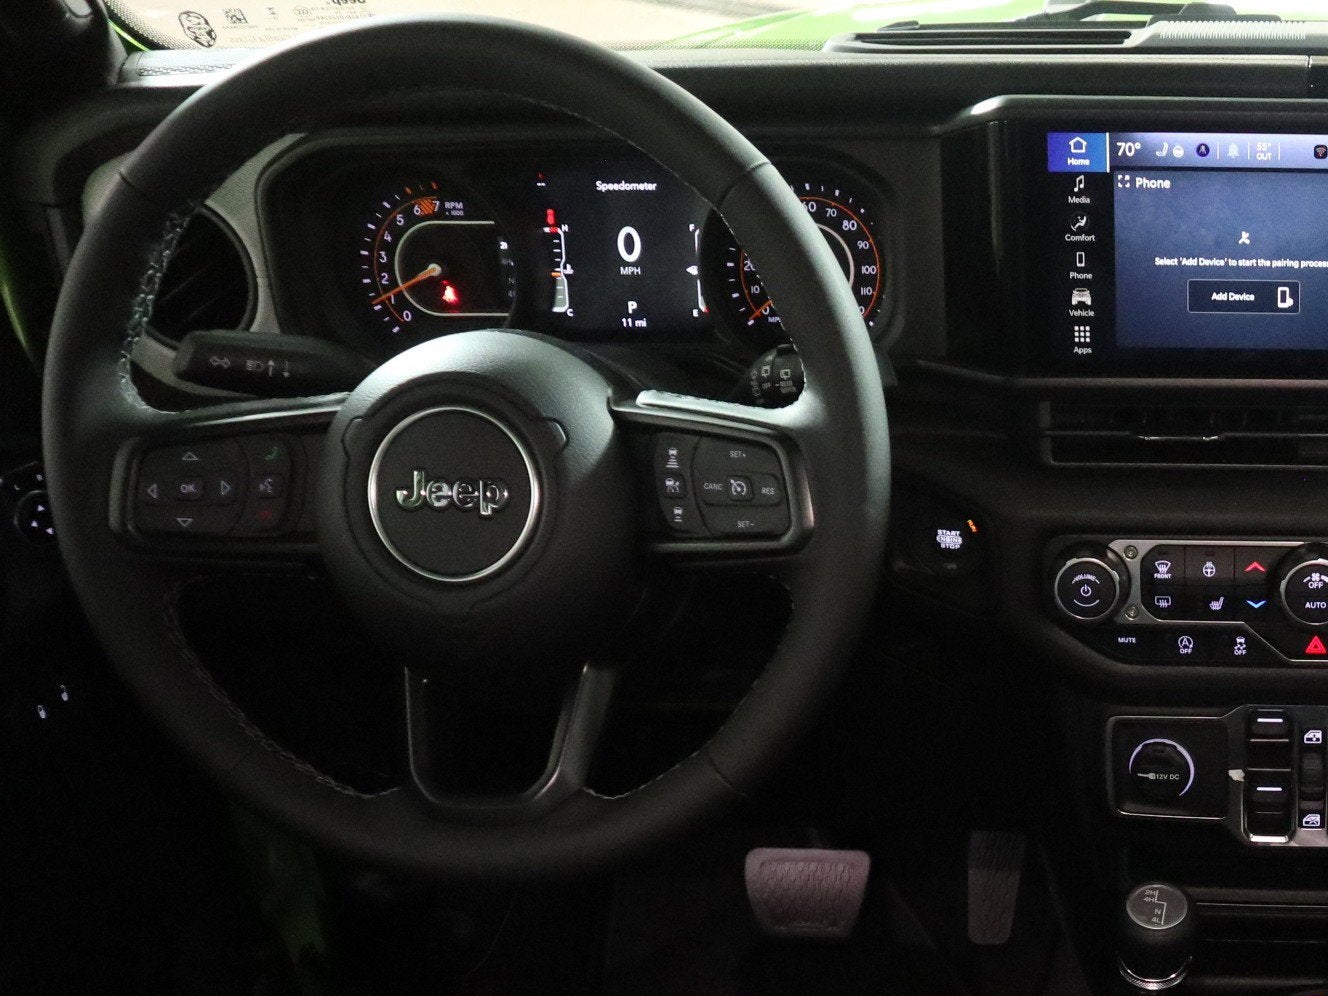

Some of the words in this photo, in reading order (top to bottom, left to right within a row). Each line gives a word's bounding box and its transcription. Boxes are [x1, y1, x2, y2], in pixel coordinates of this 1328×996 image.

[1116, 142, 1141, 157] 70°
[1256, 152, 1272, 160] OUT
[1067, 157, 1090, 166] Home
[595, 180, 658, 192] Speedometer
[1135, 177, 1171, 189] Phone
[1068, 196, 1091, 204] Media
[413, 204, 421, 215] 6
[433, 200, 440, 212] 7
[444, 201, 464, 210] RPM
[825, 208, 837, 218] 70
[396, 215, 404, 226] 5
[842, 220, 857, 231] 80
[561, 224, 569, 232] H
[384, 231, 392, 243] 4
[1065, 233, 1096, 242] Comfort
[617, 225, 642, 263] 0
[857, 240, 869, 250] 90
[379, 251, 387, 263] 3
[1155, 257, 1178, 266] Select
[1228, 258, 1236, 266] to
[1238, 258, 1257, 267] start
[1258, 258, 1270, 267] the
[1272, 259, 1299, 269] pairing
[620, 266, 641, 275] MPH
[861, 265, 877, 275] 100
[381, 272, 389, 285] 2
[1069, 271, 1093, 280] Phone
[751, 285, 760, 294] 10
[861, 286, 873, 296] 110
[1211, 292, 1228, 301] Add
[1229, 292, 1255, 301] Device
[627, 301, 637, 314] P
[1068, 308, 1095, 317] Vehicle
[403, 310, 412, 321] 0
[621, 317, 632, 327] 11
[635, 317, 647, 327] mi
[1073, 346, 1092, 355] Apps
[180, 483, 196, 493] OK
[703, 482, 724, 491] CANC
[761, 487, 775, 495] RES
[396, 470, 509, 515] Jeep
[1308, 581, 1324, 589] OFF
[1169, 773, 1180, 781] DC
